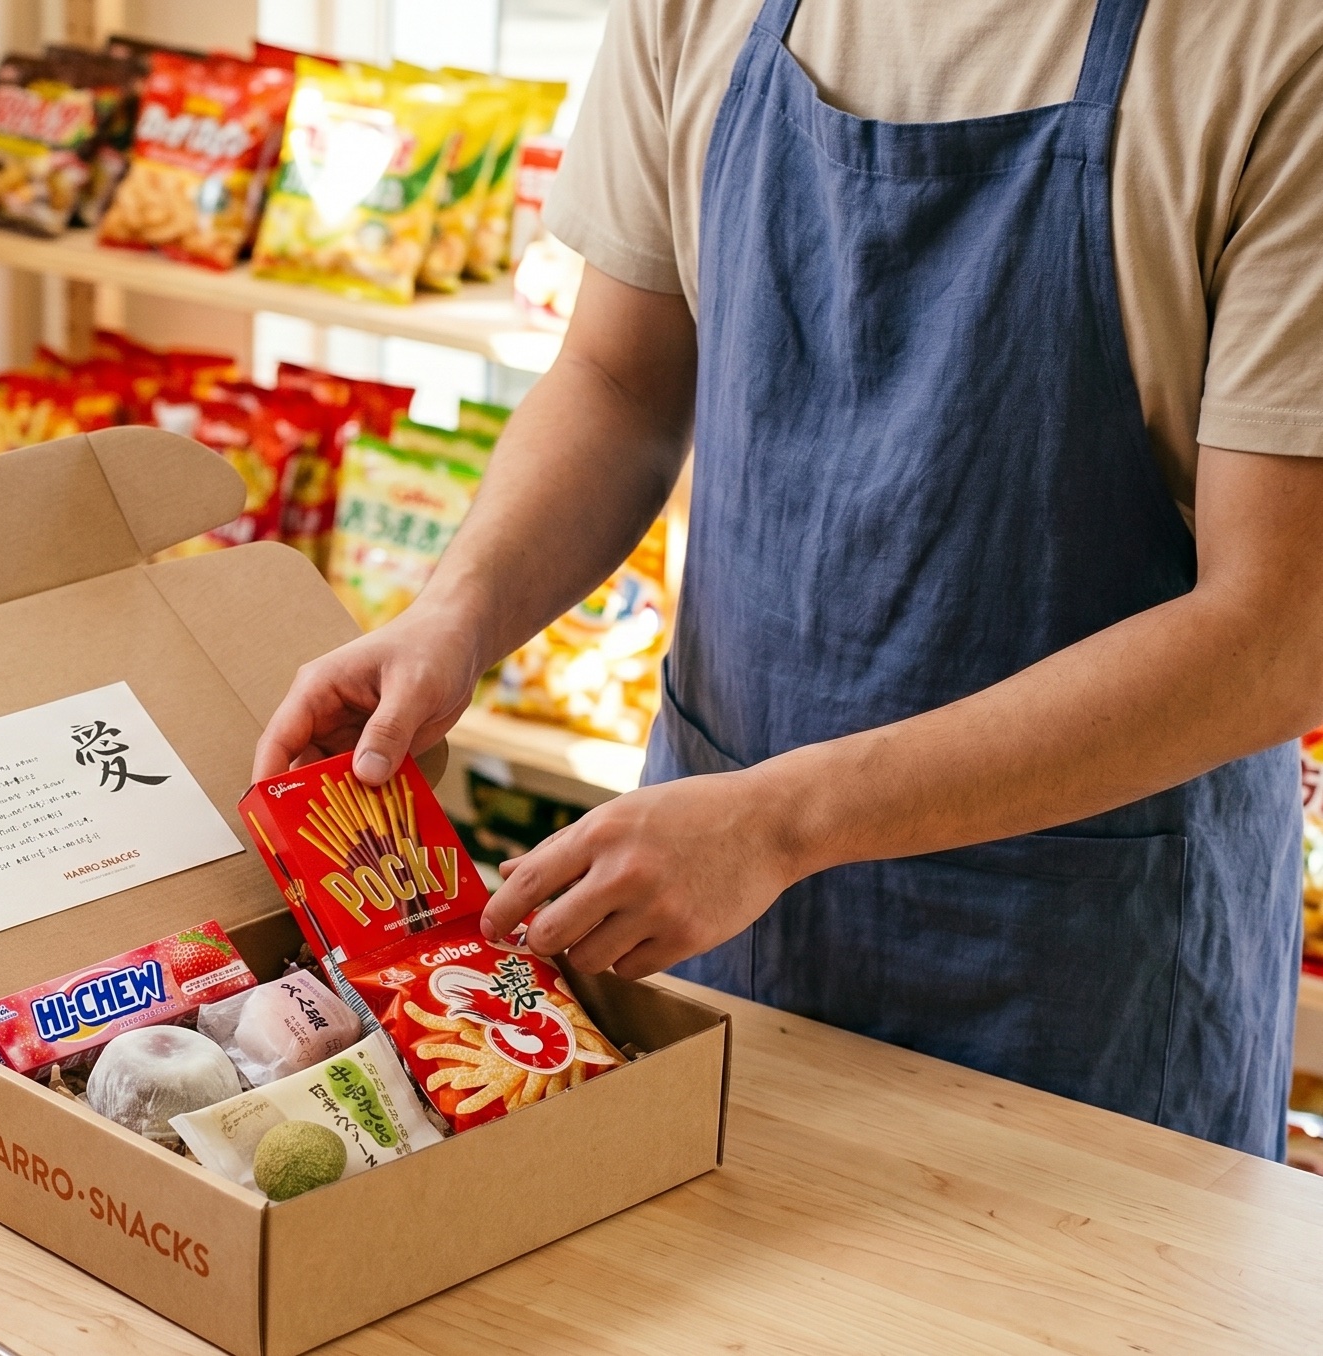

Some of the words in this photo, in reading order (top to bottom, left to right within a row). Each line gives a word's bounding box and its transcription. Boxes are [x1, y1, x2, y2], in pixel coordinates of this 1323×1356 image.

[70, 720, 172, 793] 愛
[419, 940, 483, 967] Calbee
[31, 960, 167, 1042] HI-CHEW
